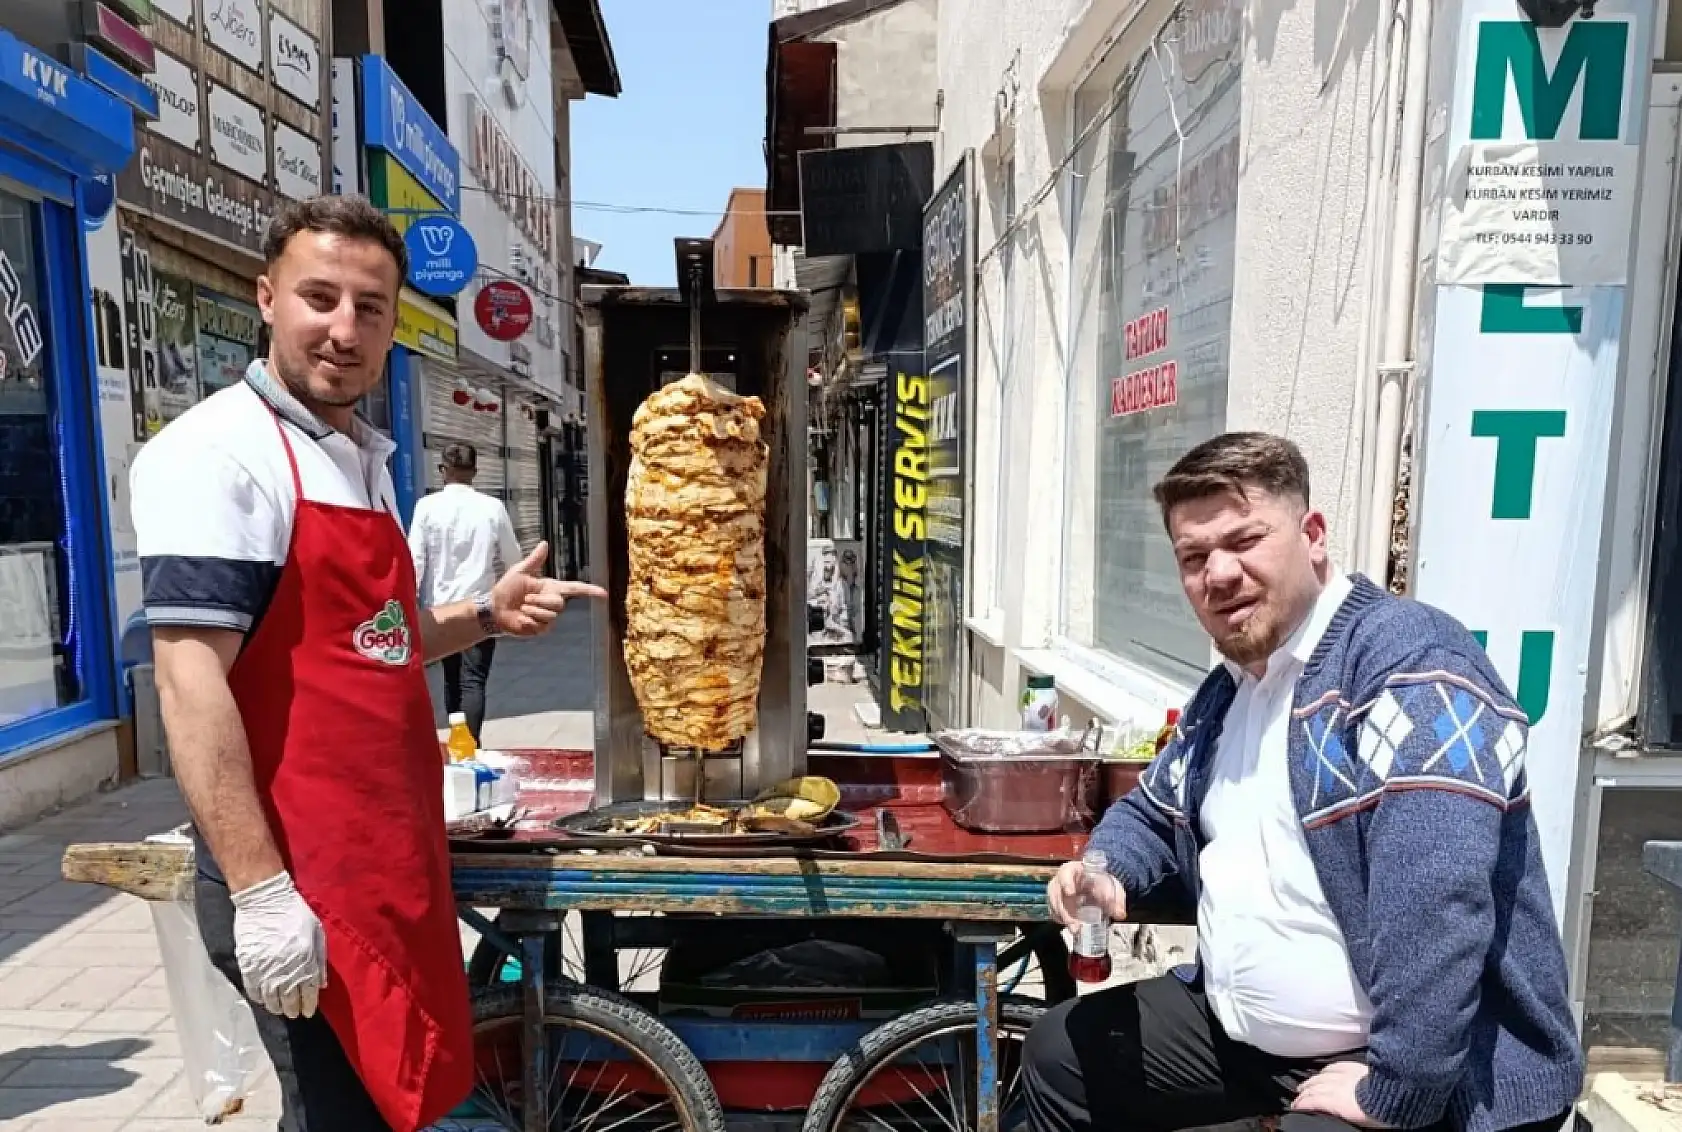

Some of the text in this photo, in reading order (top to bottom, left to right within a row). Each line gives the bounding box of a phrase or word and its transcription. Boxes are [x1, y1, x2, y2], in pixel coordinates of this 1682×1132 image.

[22, 52, 68, 98] KVK
[1467, 163, 1614, 177] KURBAN KESİMİ YAPILIR
[1512, 210, 1559, 221] VARDIR
[1502, 233, 1531, 244] 0544
[1534, 233, 1556, 244] 943
[1558, 234, 1574, 244] 33
[1576, 233, 1594, 244] 90
[425, 257, 452, 268] milli
[415, 269, 464, 281] piyango
